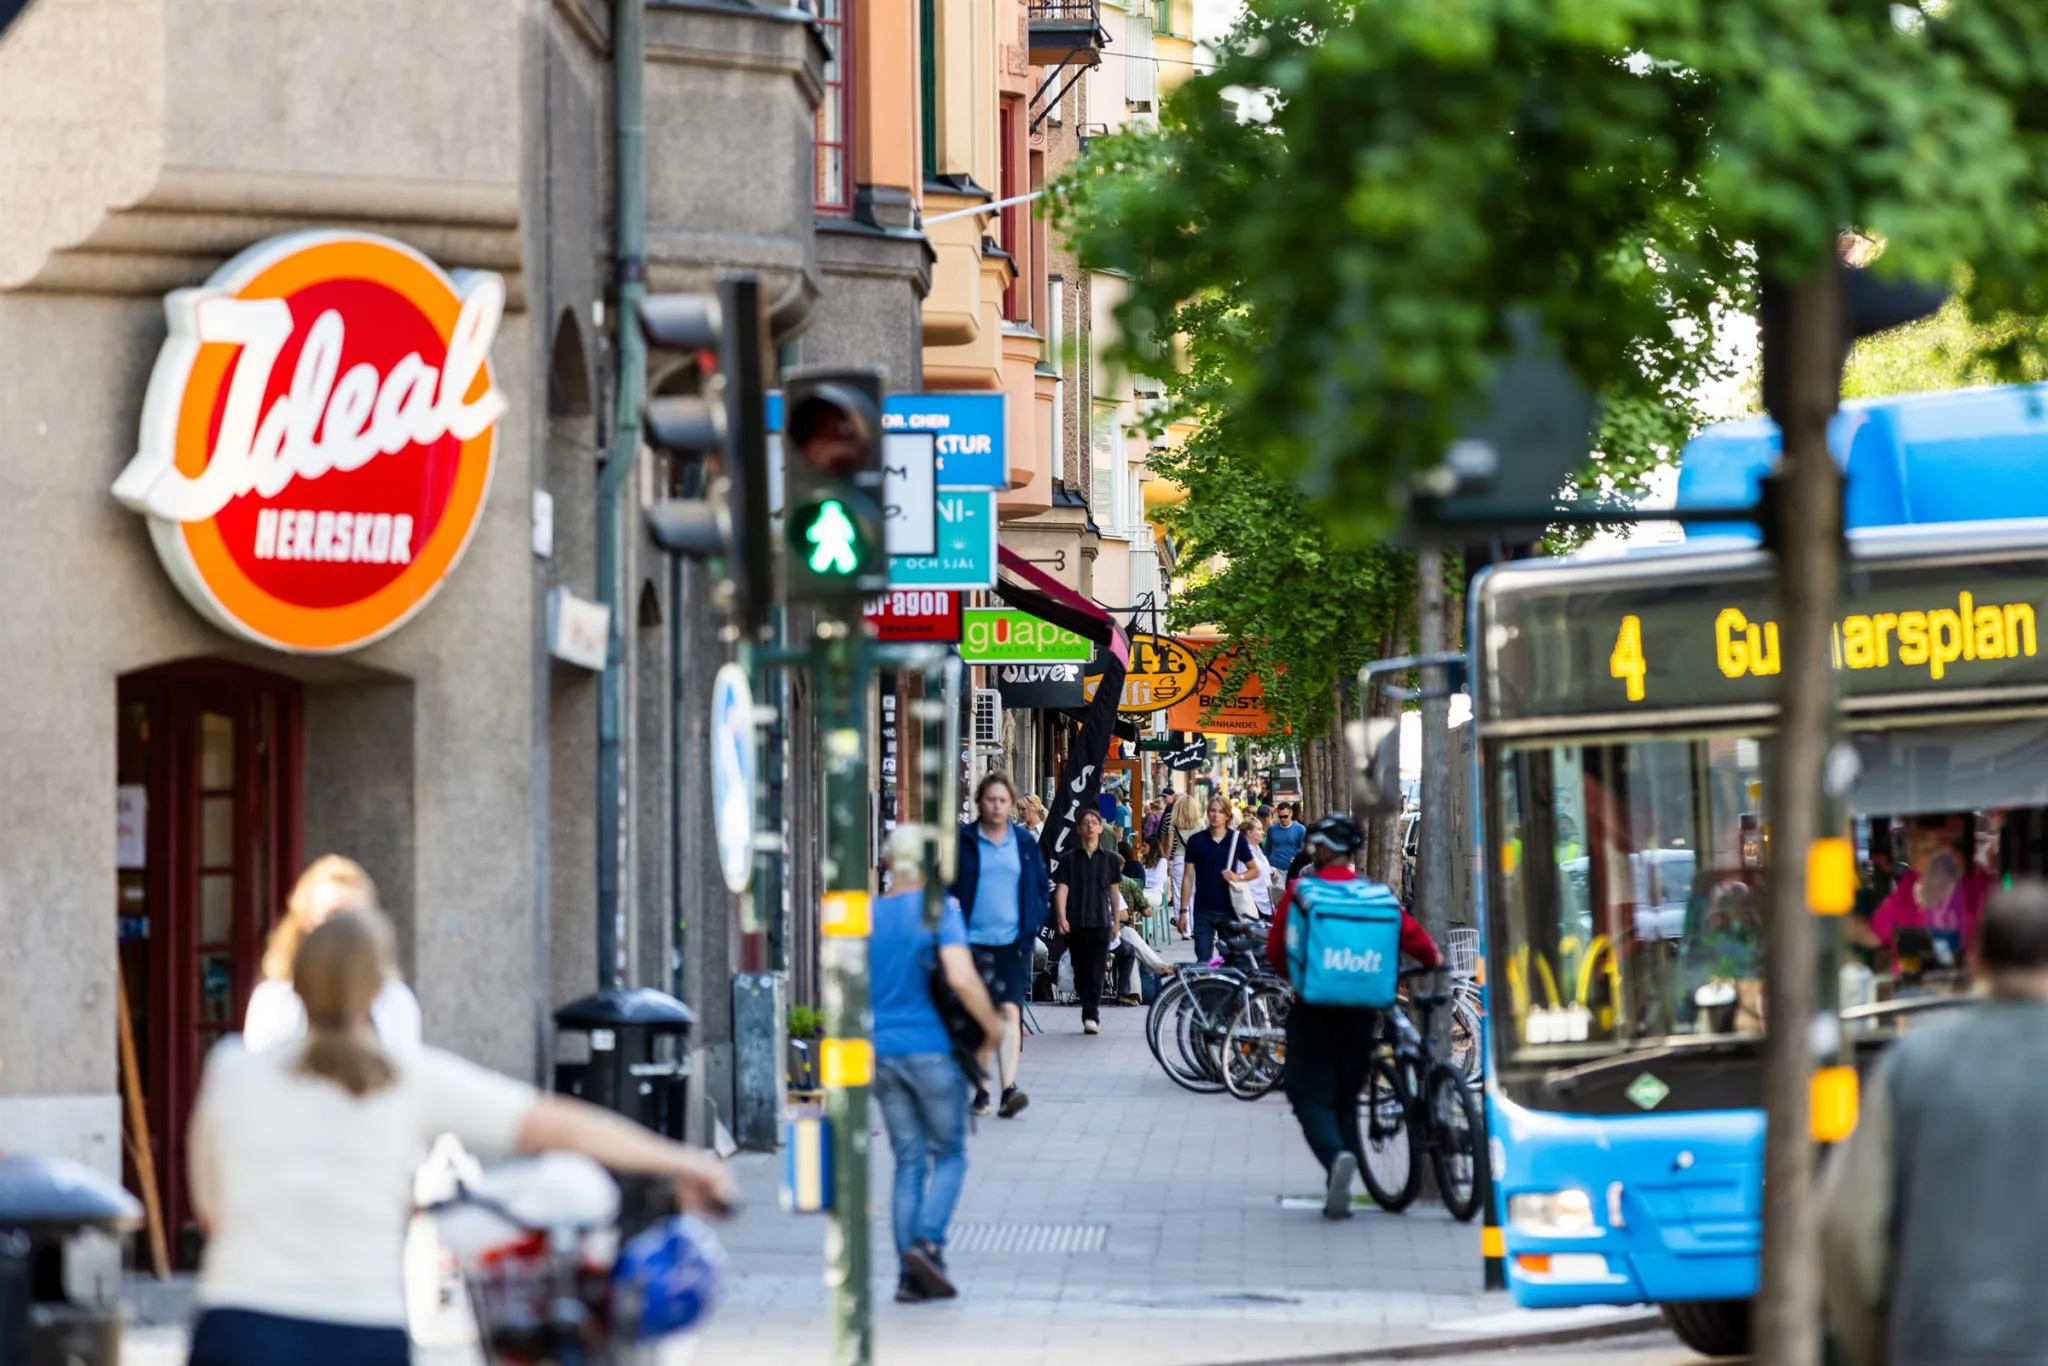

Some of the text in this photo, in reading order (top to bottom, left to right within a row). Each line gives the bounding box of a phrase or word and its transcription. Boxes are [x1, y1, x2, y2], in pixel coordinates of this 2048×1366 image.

[112, 272, 509, 522] Ideal
[254, 508, 413, 564] HERRSKOR
[906, 557, 939, 570] OCH
[967, 618, 1083, 653] guapa
[1610, 615, 1646, 701] 4
[1322, 946, 1383, 973] Wolt
